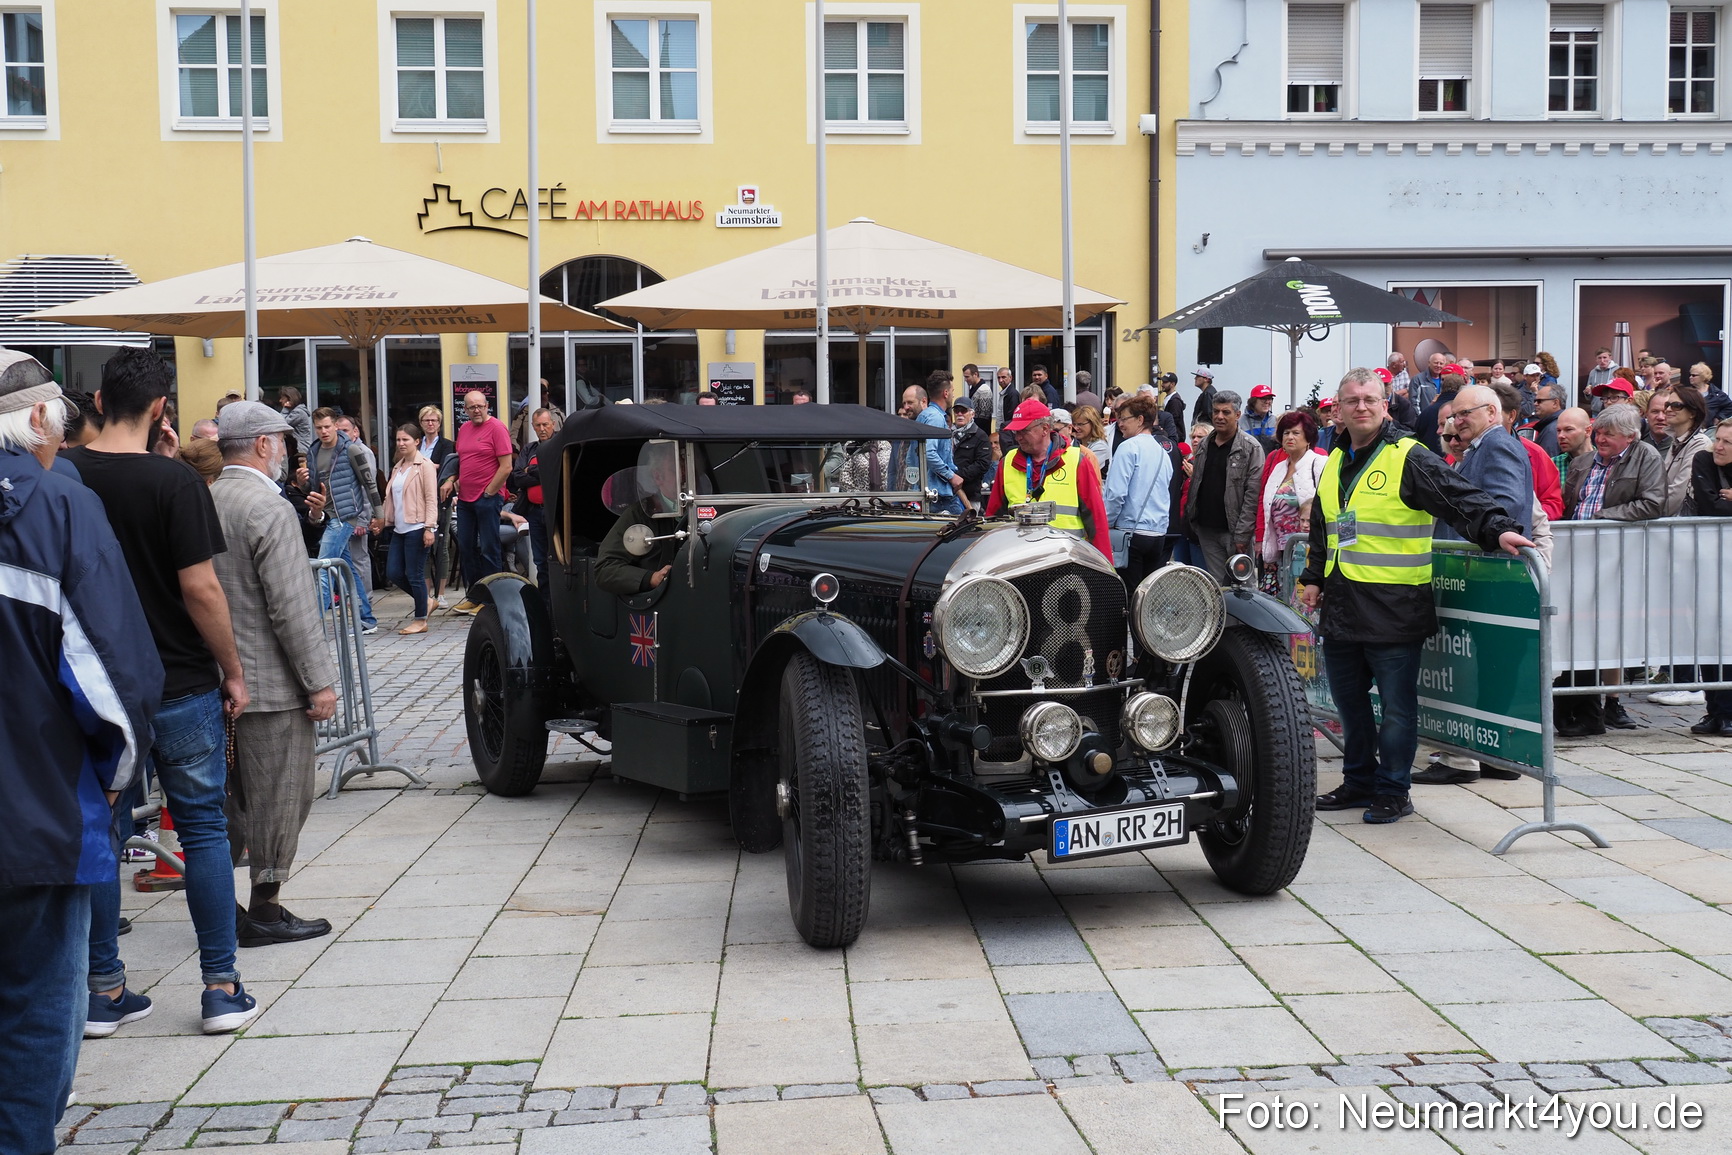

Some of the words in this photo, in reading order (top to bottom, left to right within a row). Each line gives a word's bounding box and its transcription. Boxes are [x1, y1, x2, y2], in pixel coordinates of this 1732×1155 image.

[575, 200, 607, 220] AM
[615, 200, 705, 220] RATHAUS
[727, 207, 771, 215] Neumarkter
[720, 215, 779, 225] Lammsbräu
[1122, 328, 1141, 342] 24
[1041, 573, 1092, 693] 8
[1423, 713, 1445, 734] Line:
[1446, 719, 1475, 742] 09181
[1476, 726, 1500, 749] 6352
[1069, 820, 1101, 850] AN
[1117, 814, 1147, 843] RR
[1153, 808, 1182, 838] 2H
[1058, 841, 1065, 850] D
